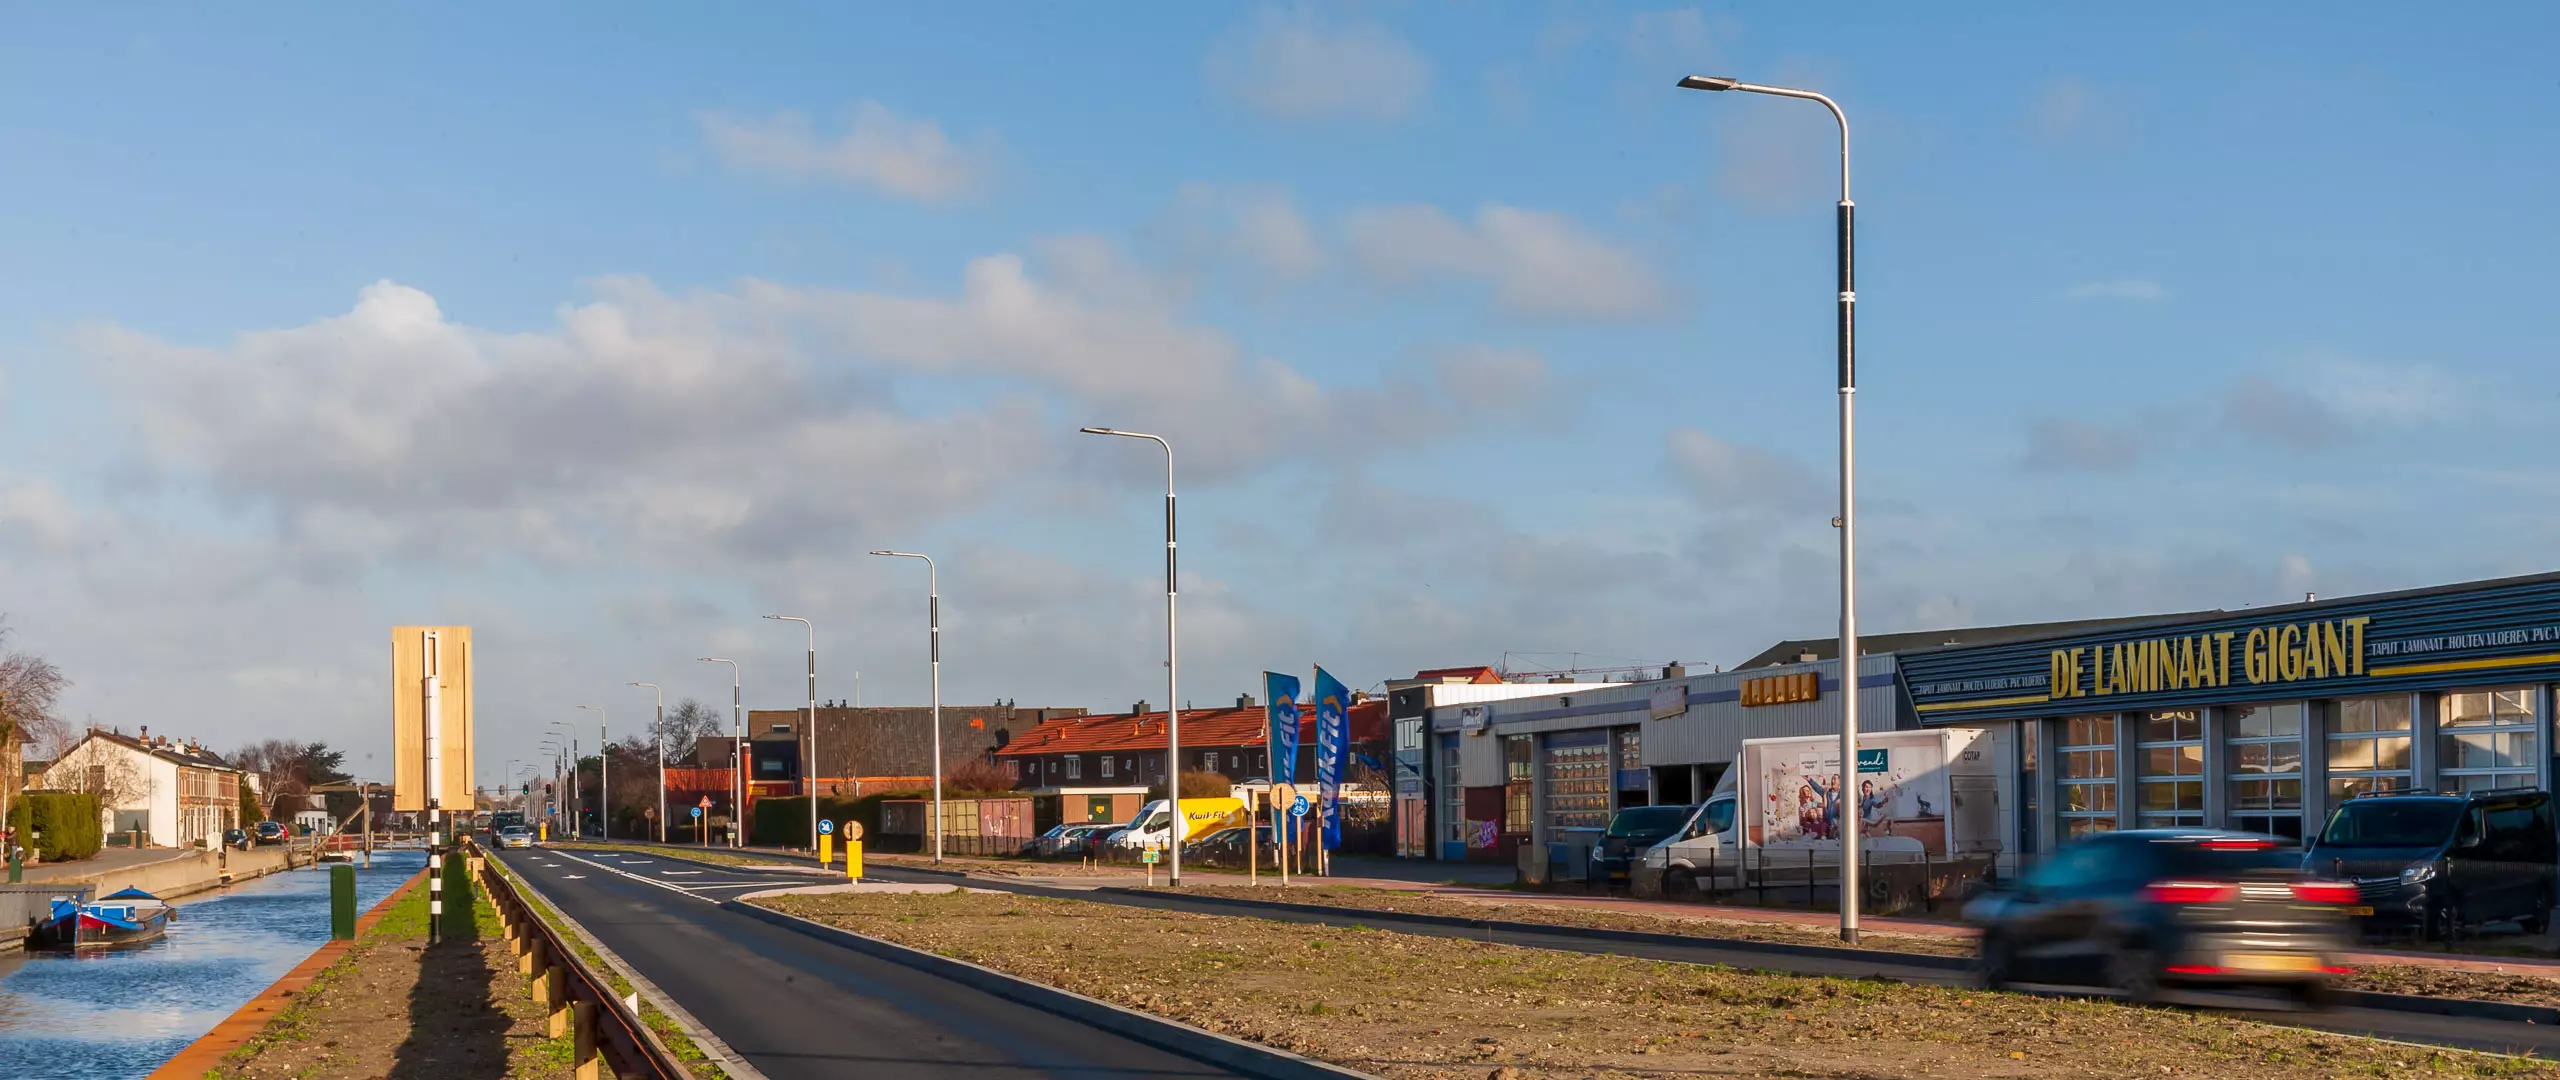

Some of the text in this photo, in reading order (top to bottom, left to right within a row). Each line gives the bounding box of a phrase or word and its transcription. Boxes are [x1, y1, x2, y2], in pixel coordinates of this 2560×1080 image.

[2051, 616, 2370, 699] DE LAMINAAT GIGANT
[2372, 641, 2398, 656] TAPIJT
[2402, 637, 2444, 653] LAMINAAT
[2449, 633, 2484, 649] HOUTEN
[2486, 629, 2529, 645] VLOEREN
[2533, 626, 2553, 641] PVC
[1278, 710, 1296, 748] Fit
[1319, 709, 1341, 754] Fit
[1189, 810, 1226, 821] Kwik Fit
